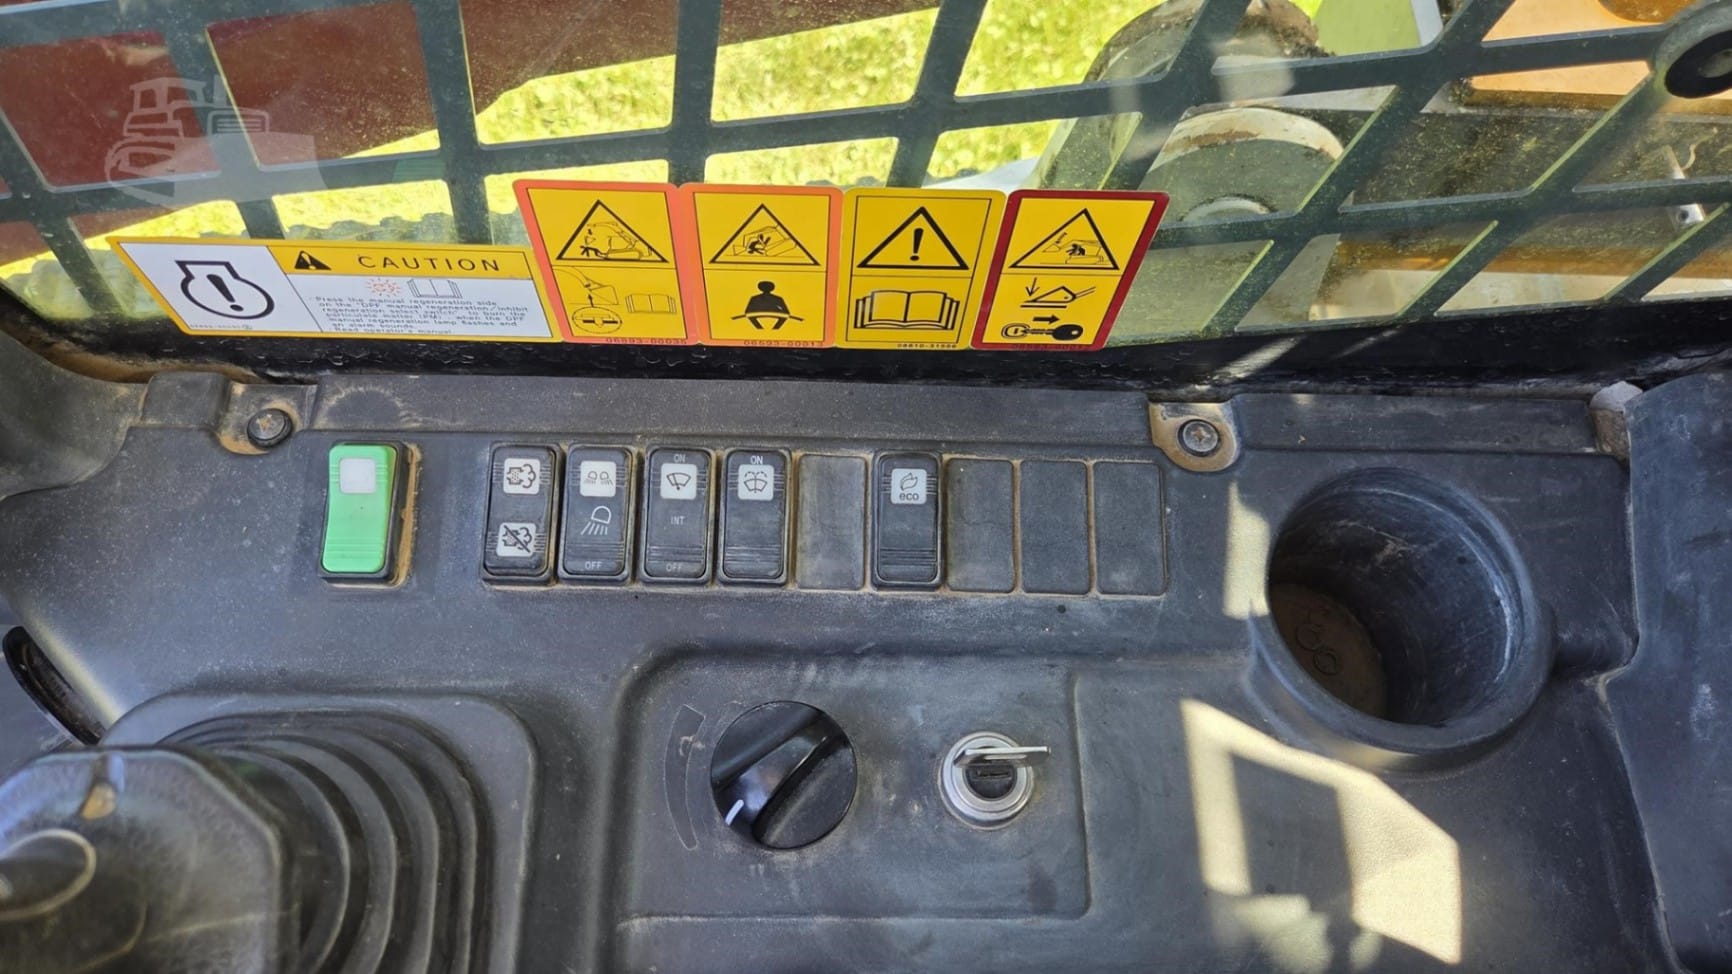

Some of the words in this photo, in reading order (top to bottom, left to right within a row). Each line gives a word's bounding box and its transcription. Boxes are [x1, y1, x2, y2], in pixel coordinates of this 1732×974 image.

[357, 255, 500, 271] CAUTION
[673, 453, 687, 464] ON
[750, 455, 764, 465] ON
[899, 492, 919, 501] eco
[670, 515, 686, 526] INT
[584, 561, 603, 571] OFF
[665, 562, 684, 572] OFF
